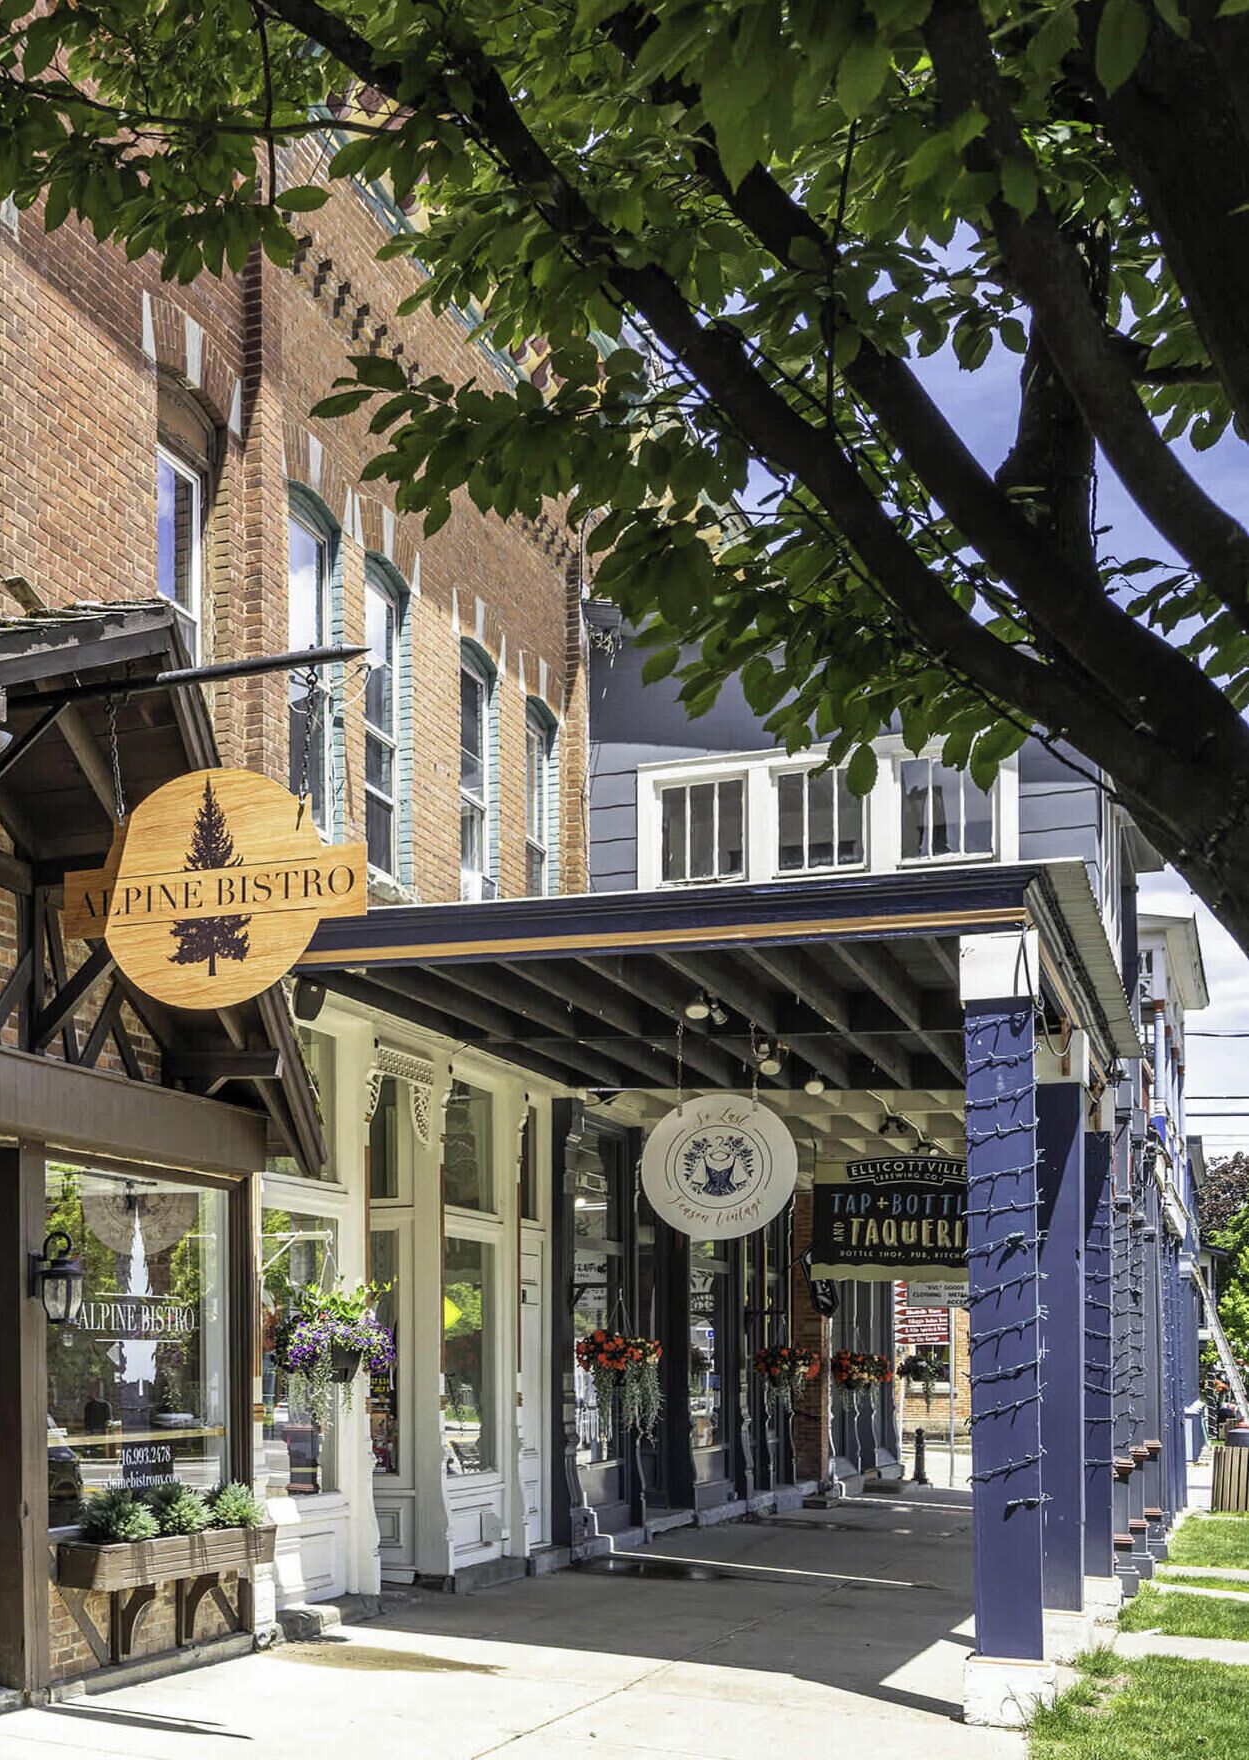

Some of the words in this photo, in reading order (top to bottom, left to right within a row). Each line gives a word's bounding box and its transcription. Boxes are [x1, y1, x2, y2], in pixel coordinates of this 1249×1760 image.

[78, 880, 204, 918] ALPINE
[217, 864, 355, 906] BISTRO
[851, 1161, 967, 1176] ELLICOTTVILLE
[831, 1193, 871, 1215] TAP
[833, 1221, 845, 1242] AND
[850, 1218, 969, 1248] TAQUERI
[78, 1301, 137, 1330] ALPINE
[141, 1305, 195, 1332] BISTRO
